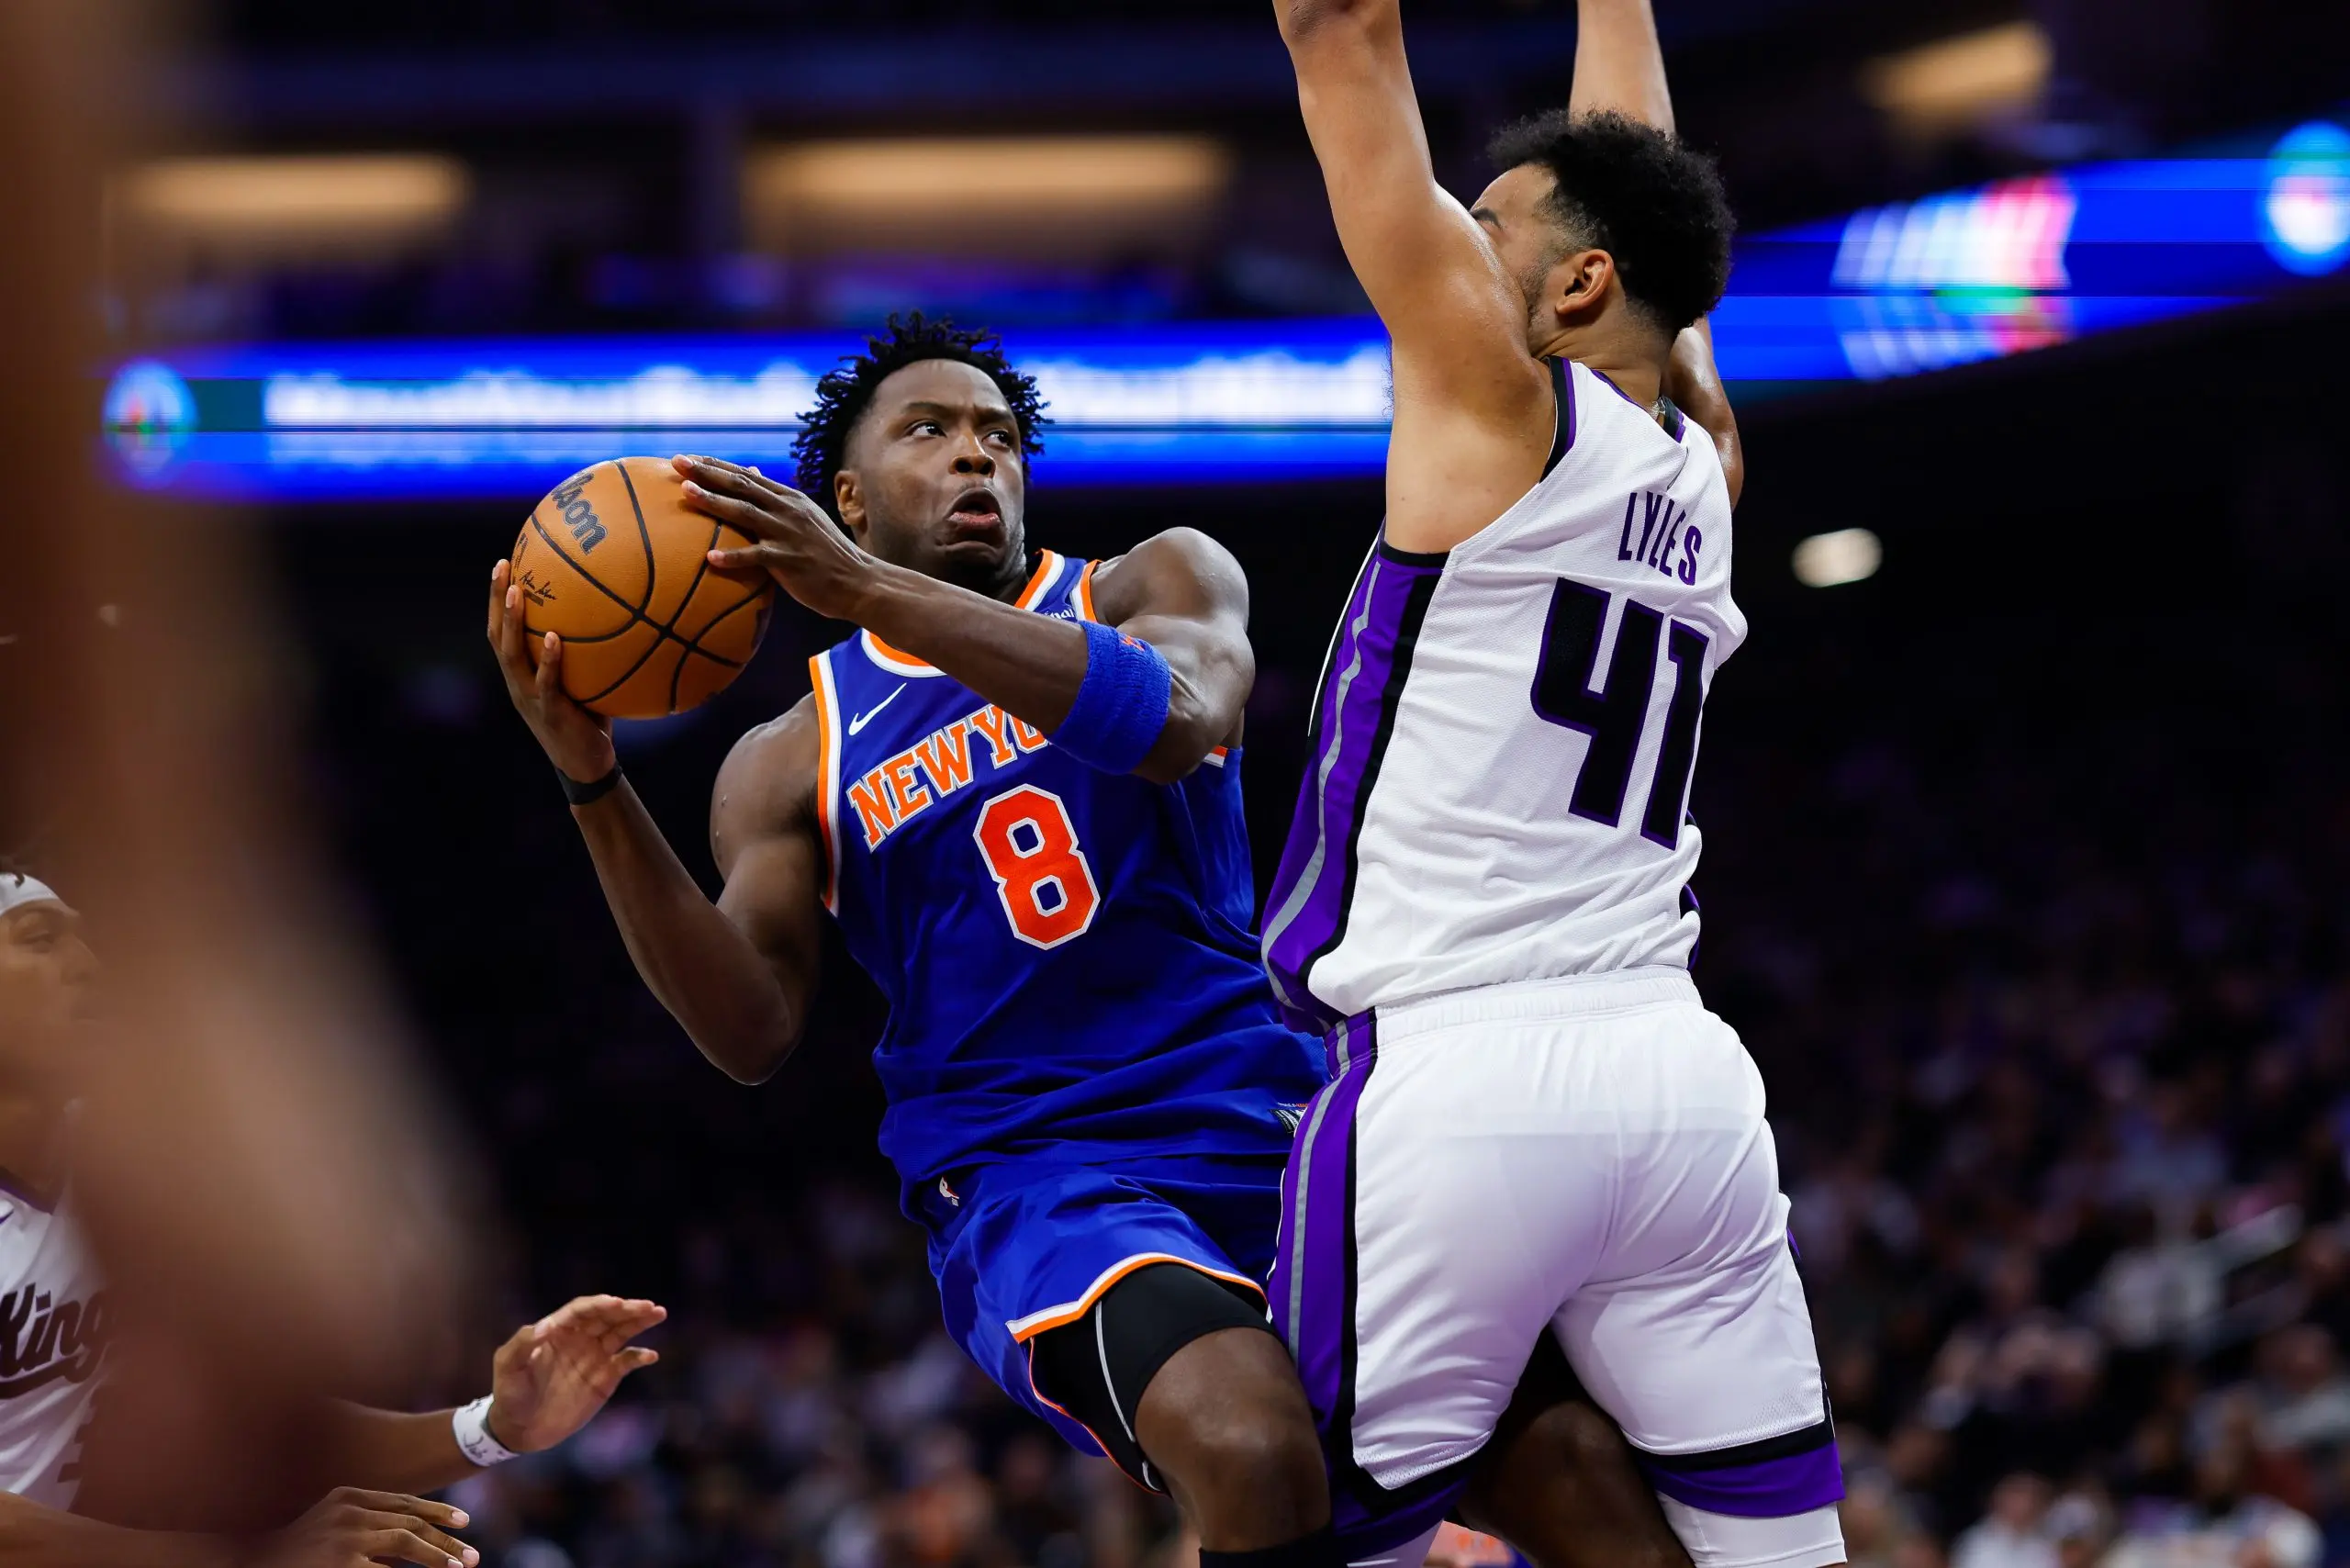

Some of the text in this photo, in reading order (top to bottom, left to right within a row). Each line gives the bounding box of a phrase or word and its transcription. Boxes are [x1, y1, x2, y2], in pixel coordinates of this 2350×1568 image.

[1617, 491, 1702, 586] LYLES
[1530, 577, 1710, 851] 41
[846, 715, 974, 852] NEW
[973, 783, 1102, 950] 8
[0, 1282, 117, 1399] King
